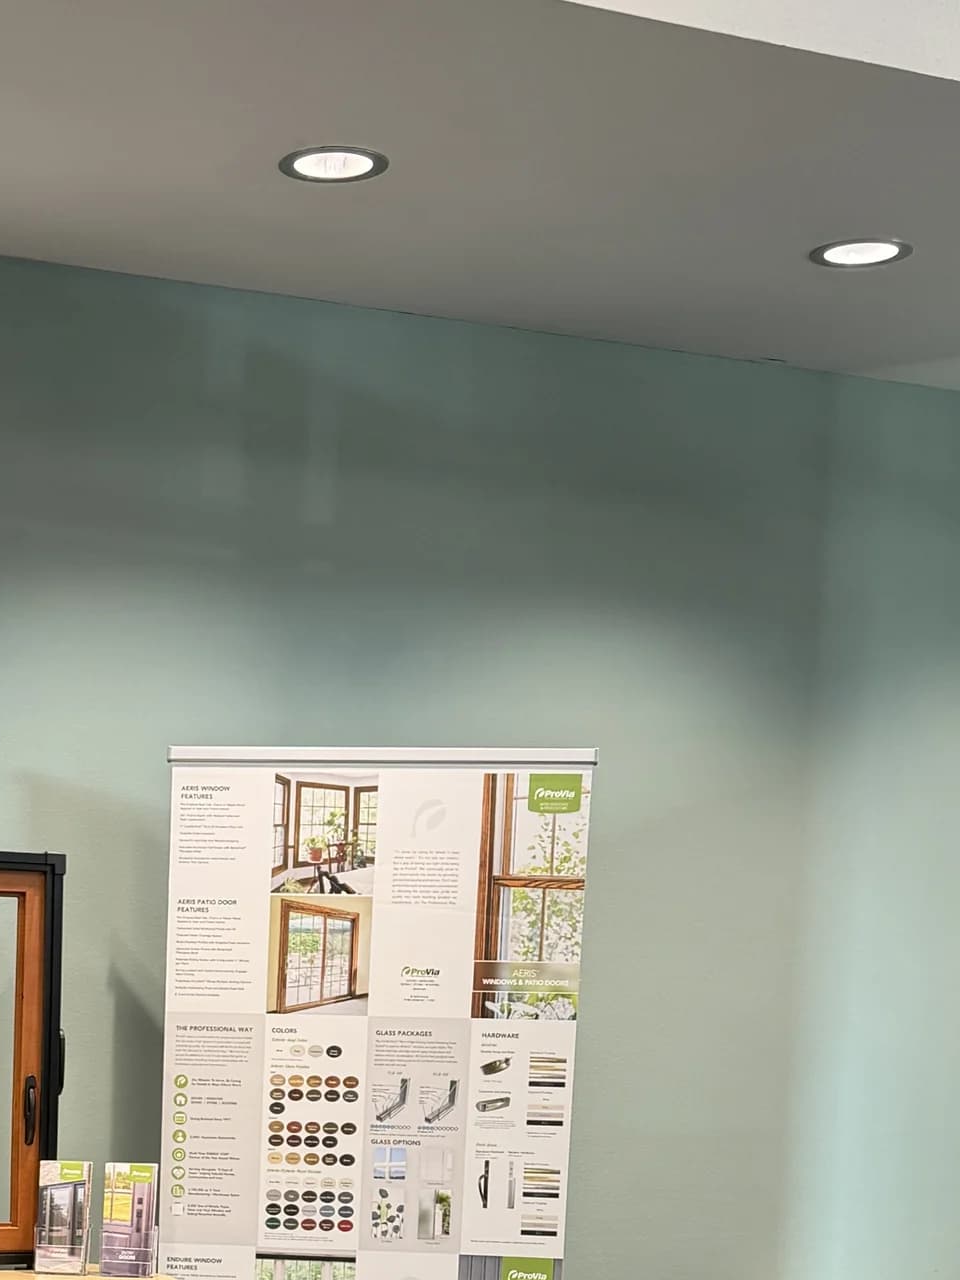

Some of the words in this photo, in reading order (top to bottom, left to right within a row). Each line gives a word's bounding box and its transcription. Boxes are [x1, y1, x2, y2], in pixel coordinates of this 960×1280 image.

[544, 789, 576, 799] ProVia
[410, 967, 441, 977] ProVia
[512, 968, 538, 978] AERIS
[517, 1271, 547, 1280] ProVia
